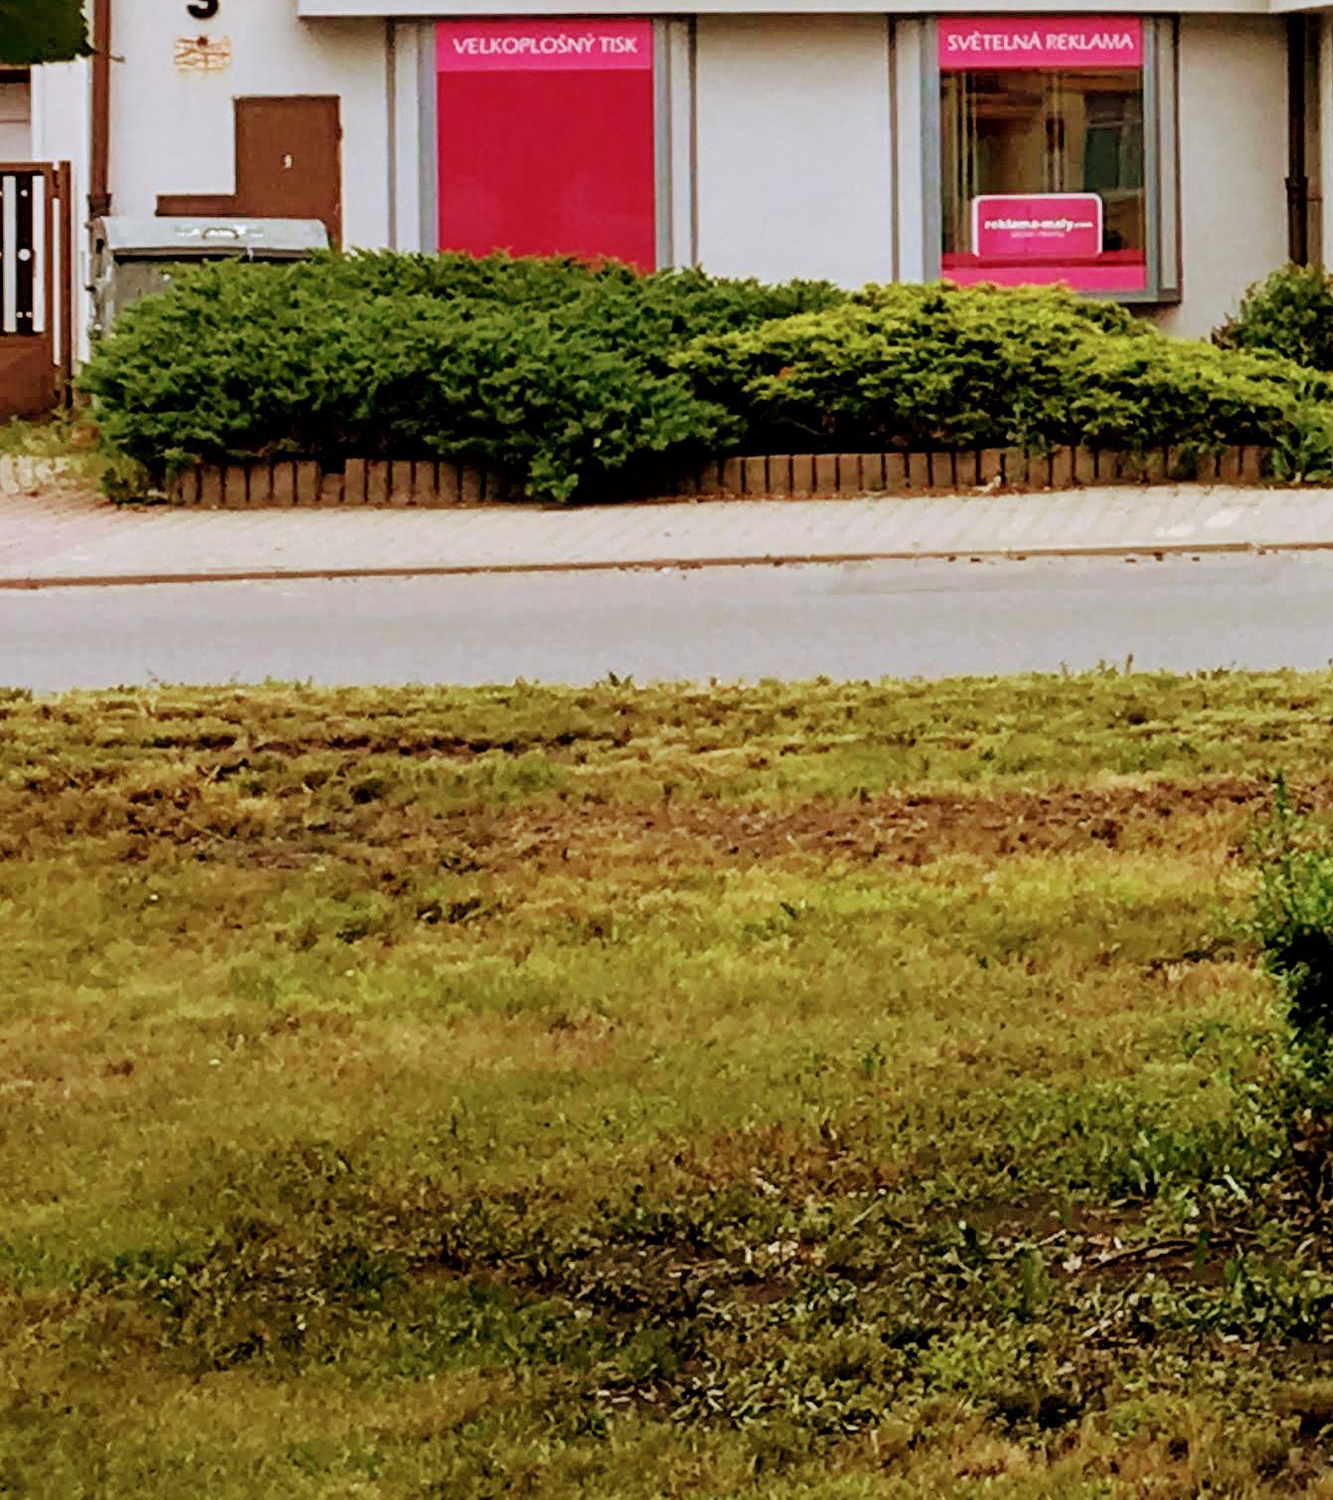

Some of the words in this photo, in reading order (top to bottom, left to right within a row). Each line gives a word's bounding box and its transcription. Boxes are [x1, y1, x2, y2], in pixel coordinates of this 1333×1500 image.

[452, 33, 596, 54] VELKOPLOŠNÝ
[600, 36, 638, 54] TISK
[947, 31, 1042, 52] SVĚTELNÁ
[1046, 33, 1134, 51] REKLAMA
